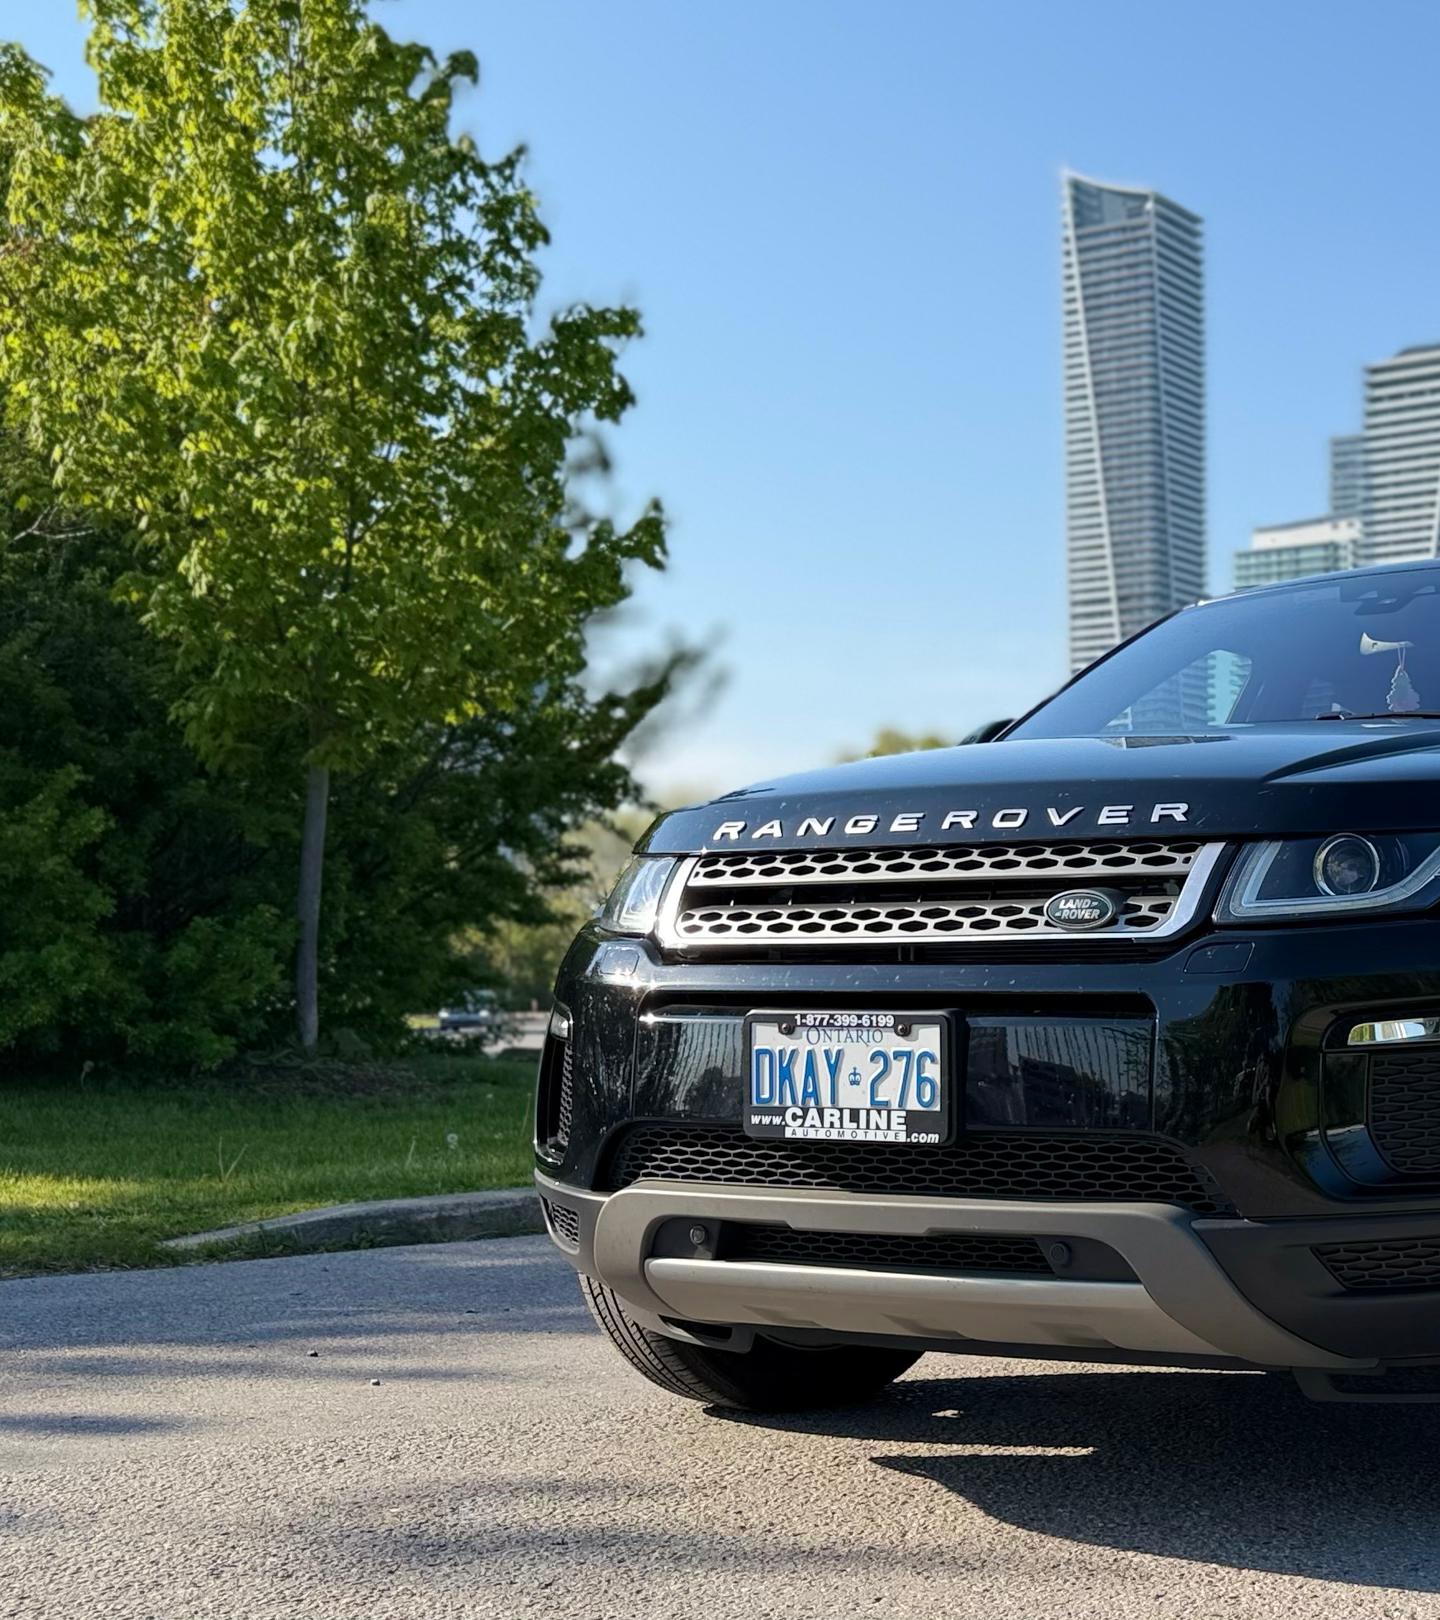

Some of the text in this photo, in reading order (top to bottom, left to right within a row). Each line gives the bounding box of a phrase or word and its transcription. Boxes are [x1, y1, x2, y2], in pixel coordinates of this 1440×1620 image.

[713, 802, 1190, 841] RANGE ROVER
[1058, 899, 1092, 909] LAND
[1061, 908, 1101, 920] ROVER
[794, 1013, 895, 1027] 1-877-399-6199
[806, 1026, 884, 1047] ONTARIO
[754, 1047, 938, 1109] DKAY 276
[790, 1127, 902, 1141] AUTOMOTIVE
